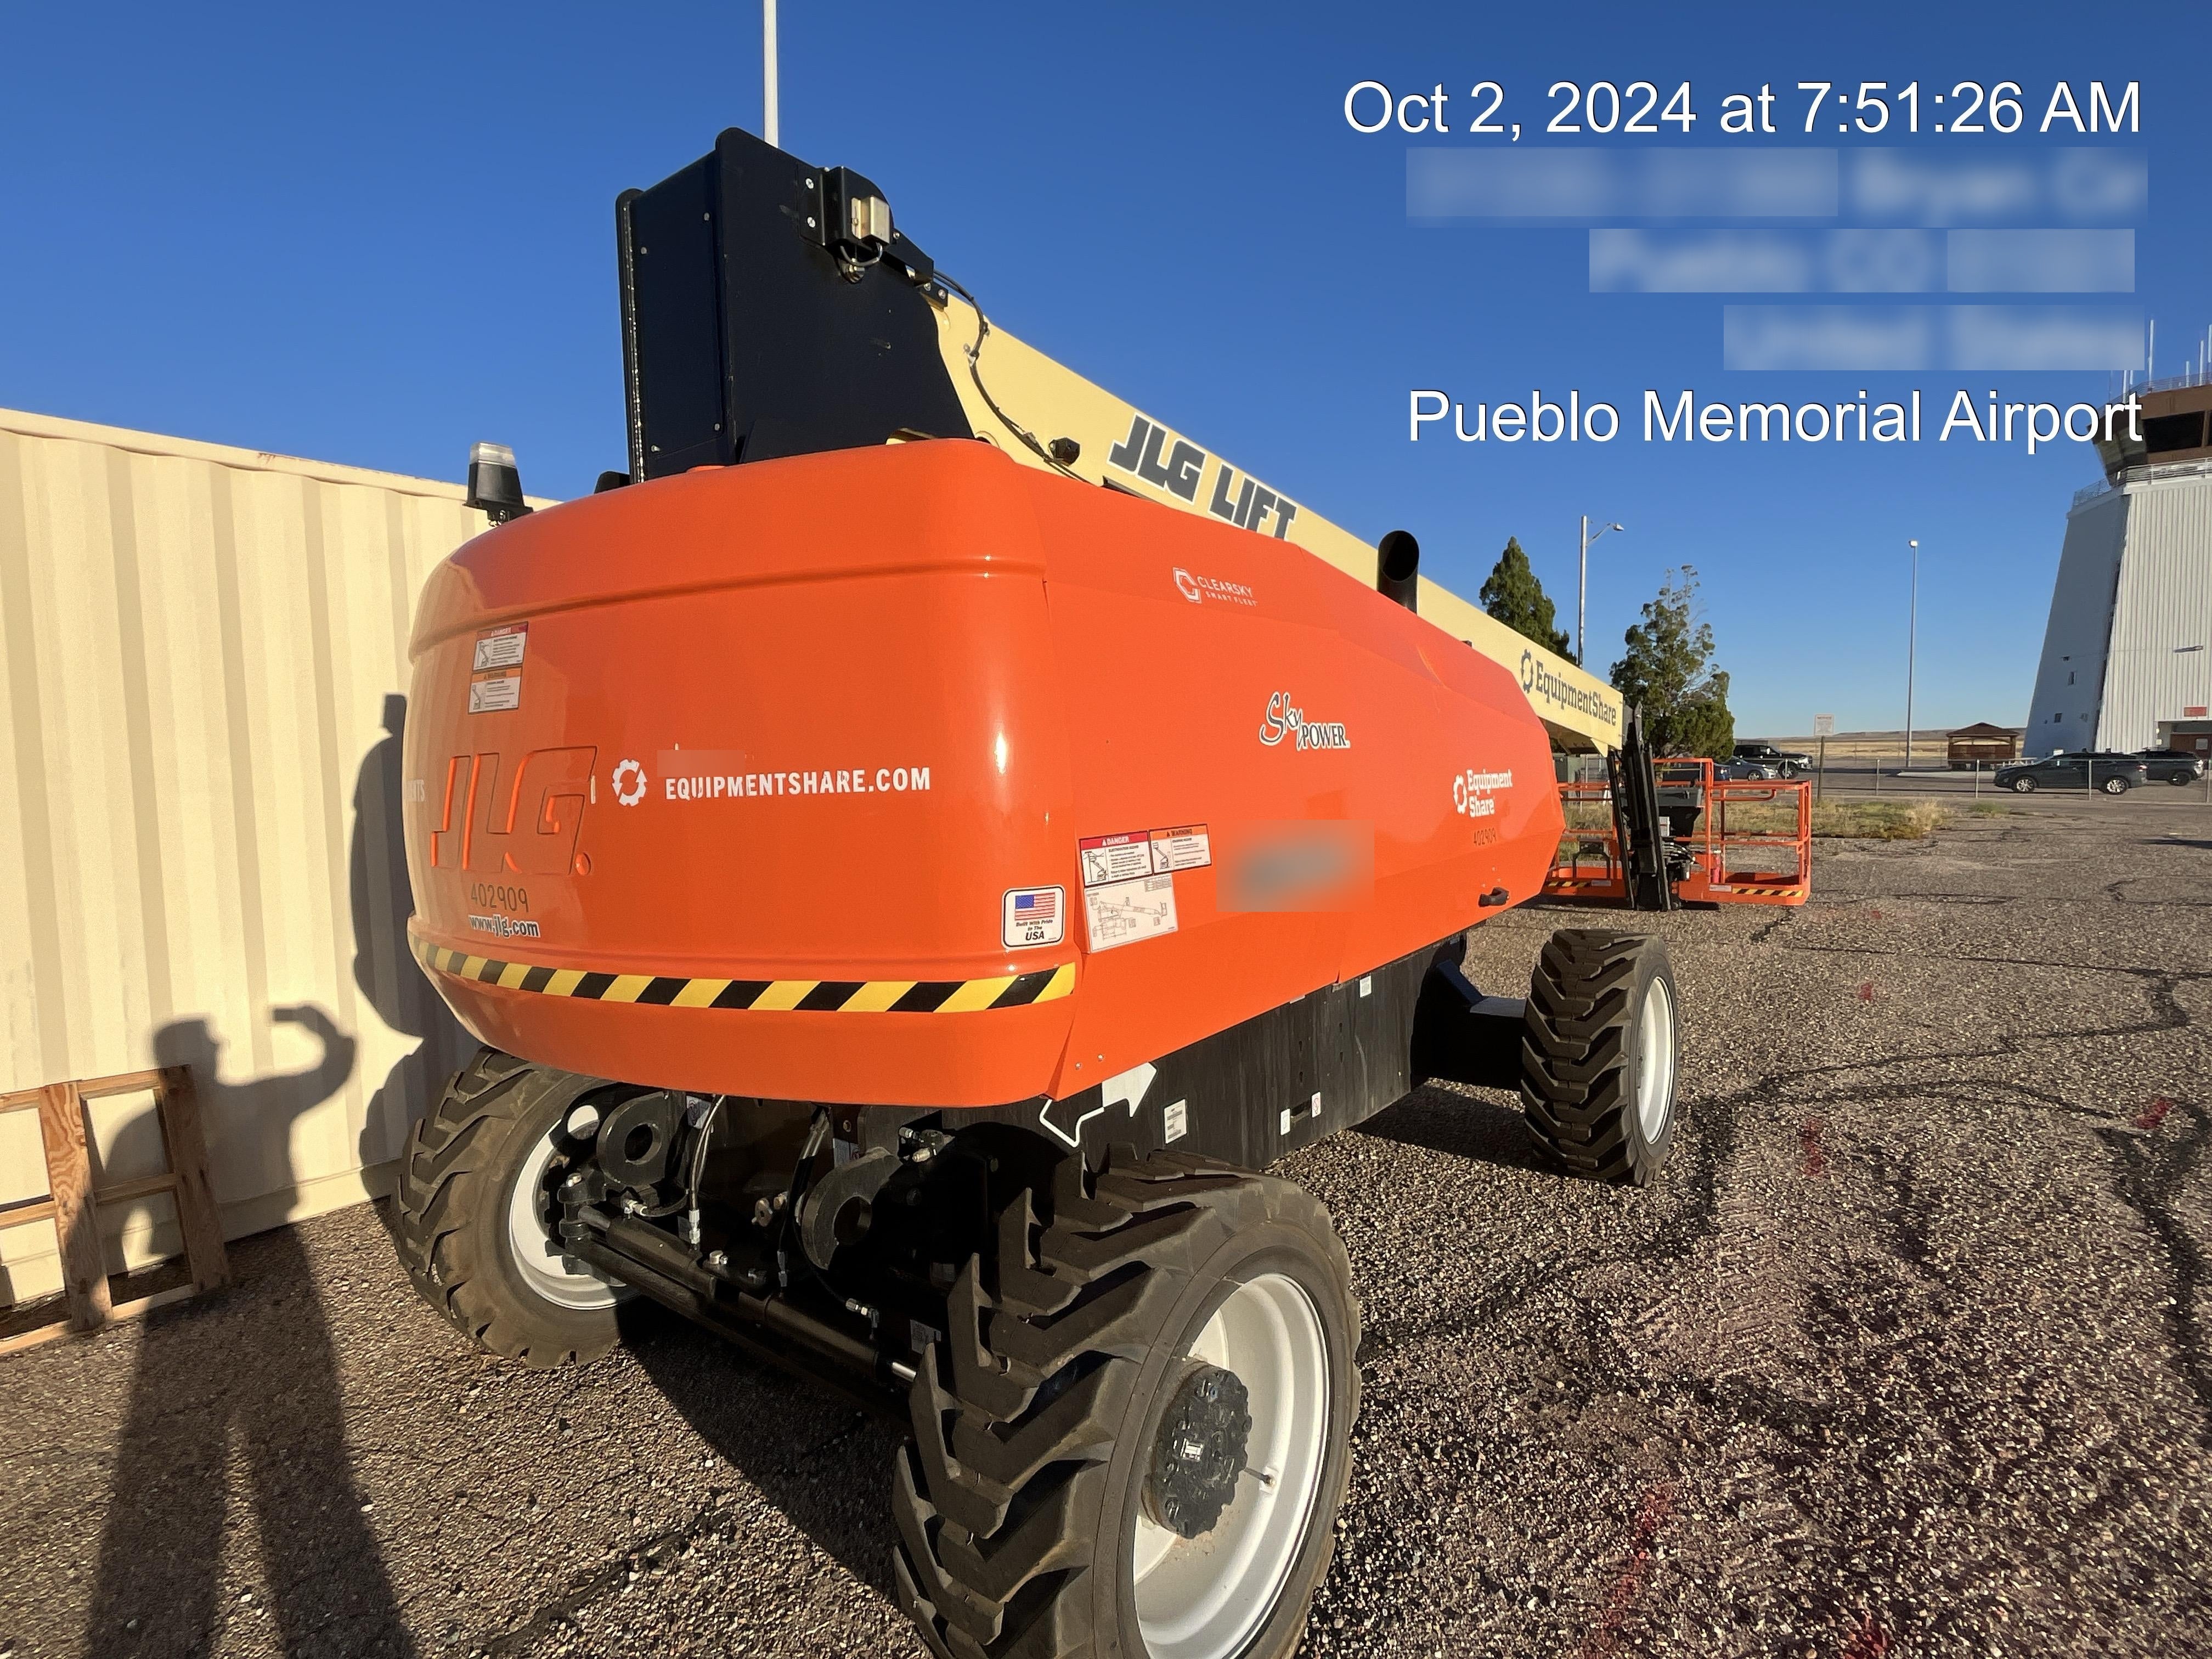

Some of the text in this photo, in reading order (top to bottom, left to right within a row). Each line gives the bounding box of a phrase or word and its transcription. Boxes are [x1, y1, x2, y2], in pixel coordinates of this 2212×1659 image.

[1107, 411, 1298, 540] JLG LIFT
[1197, 575, 1254, 597] CLEARSKY
[1536, 659, 1617, 727] EquipmentShare
[1260, 692, 1302, 750] Sky
[1300, 724, 1347, 748] POWER
[665, 767, 931, 802] EQUIPMENTSHARE.COM
[1466, 768, 1513, 795] Equipment
[1469, 795, 1495, 817] Share
[1473, 827, 1497, 846] 402909
[470, 882, 529, 913] 402909
[469, 914, 540, 938] www.jlg.com
[1025, 930, 1045, 941] USA
